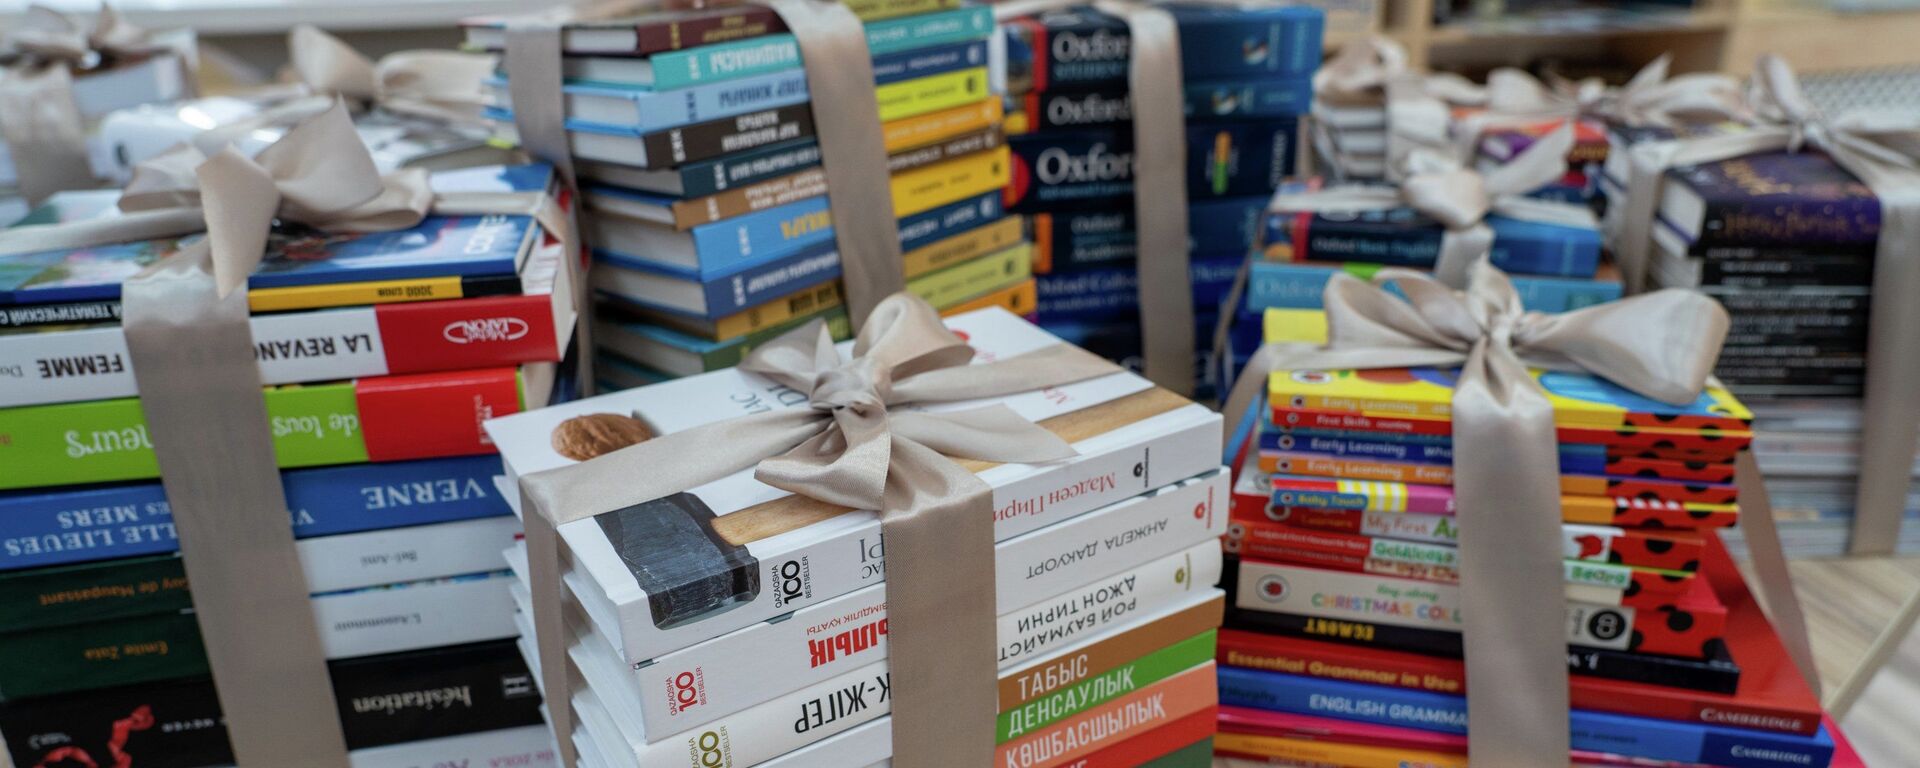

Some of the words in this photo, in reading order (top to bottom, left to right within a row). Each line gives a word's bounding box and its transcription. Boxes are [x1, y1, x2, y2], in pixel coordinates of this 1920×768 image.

[1052, 28, 1129, 63] Oxfor
[1036, 142, 1136, 185] Oxfor
[343, 334, 372, 352] LA
[36, 354, 124, 379] FEMME
[1310, 438, 1346, 455] Early
[1348, 439, 1407, 457] Learning
[360, 478, 487, 511] VERNE
[56, 502, 139, 530] MERS
[4, 528, 114, 557] LIEUES
[1104, 518, 1169, 550] АНЖЕЛА
[1025, 539, 1099, 580] ДАКУОРТ
[769, 564, 782, 609] QAZAQSHA
[781, 560, 803, 605] 100
[802, 555, 812, 599] BESTSELLER
[1083, 574, 1137, 607] ДЖОН
[1017, 599, 1080, 634] ТИРНИ
[1101, 597, 1137, 624] РОЙ
[1310, 592, 1413, 619] CHRISTMAS
[1416, 603, 1464, 624] COLL
[997, 610, 1097, 663] БАУМАЙСТ
[675, 671, 698, 713] 100
[696, 665, 707, 705] BESTSELLER
[1017, 653, 1089, 701] ТАБЫС
[1308, 660, 1398, 684] Grammar
[1400, 670, 1420, 688] in
[1423, 673, 1459, 692] Use
[664, 676, 678, 716] QAZAQSHA
[1309, 693, 1386, 717] ENGLISH
[1388, 702, 1468, 727] GRAMMA
